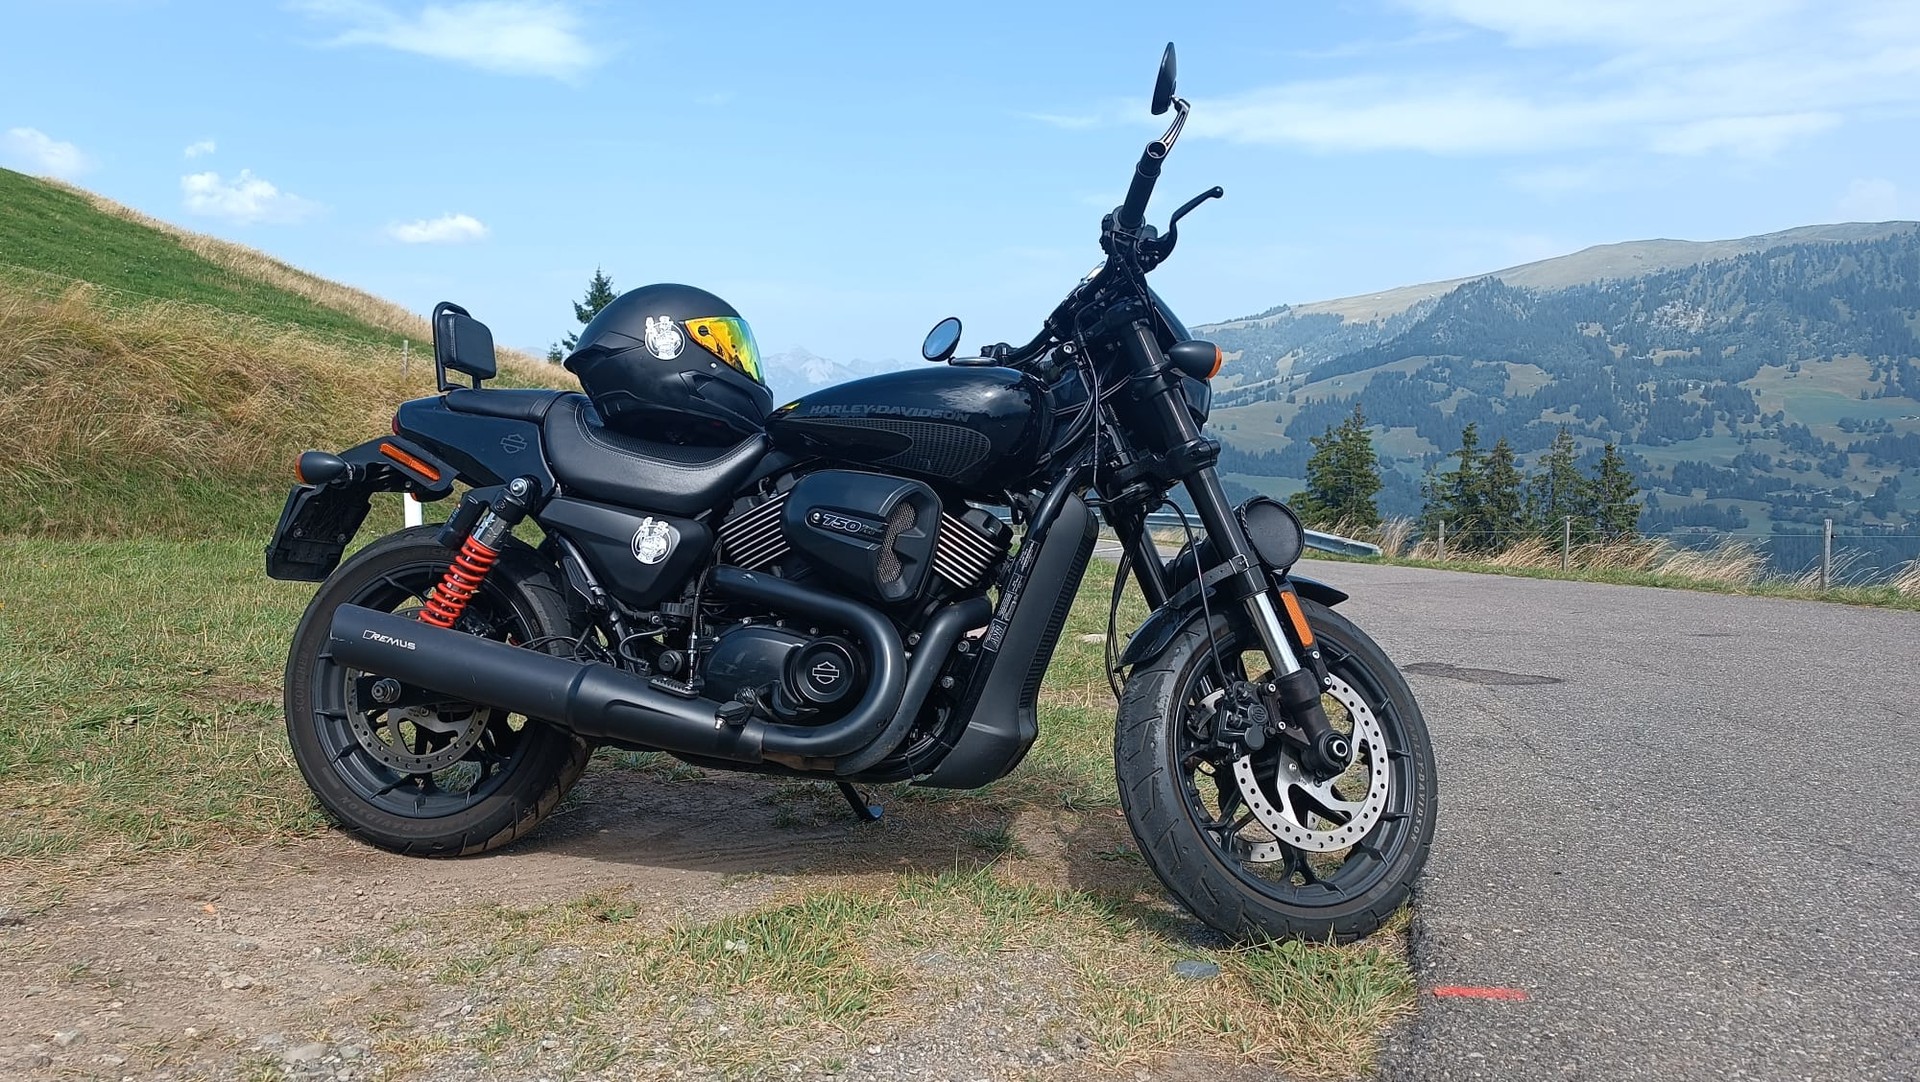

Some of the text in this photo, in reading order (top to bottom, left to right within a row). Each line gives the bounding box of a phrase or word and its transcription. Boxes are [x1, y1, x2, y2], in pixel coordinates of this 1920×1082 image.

[809, 403, 971, 423] HARLEY-DAVIDSON
[822, 513, 862, 533] 750
[370, 631, 416, 651] REMUS
